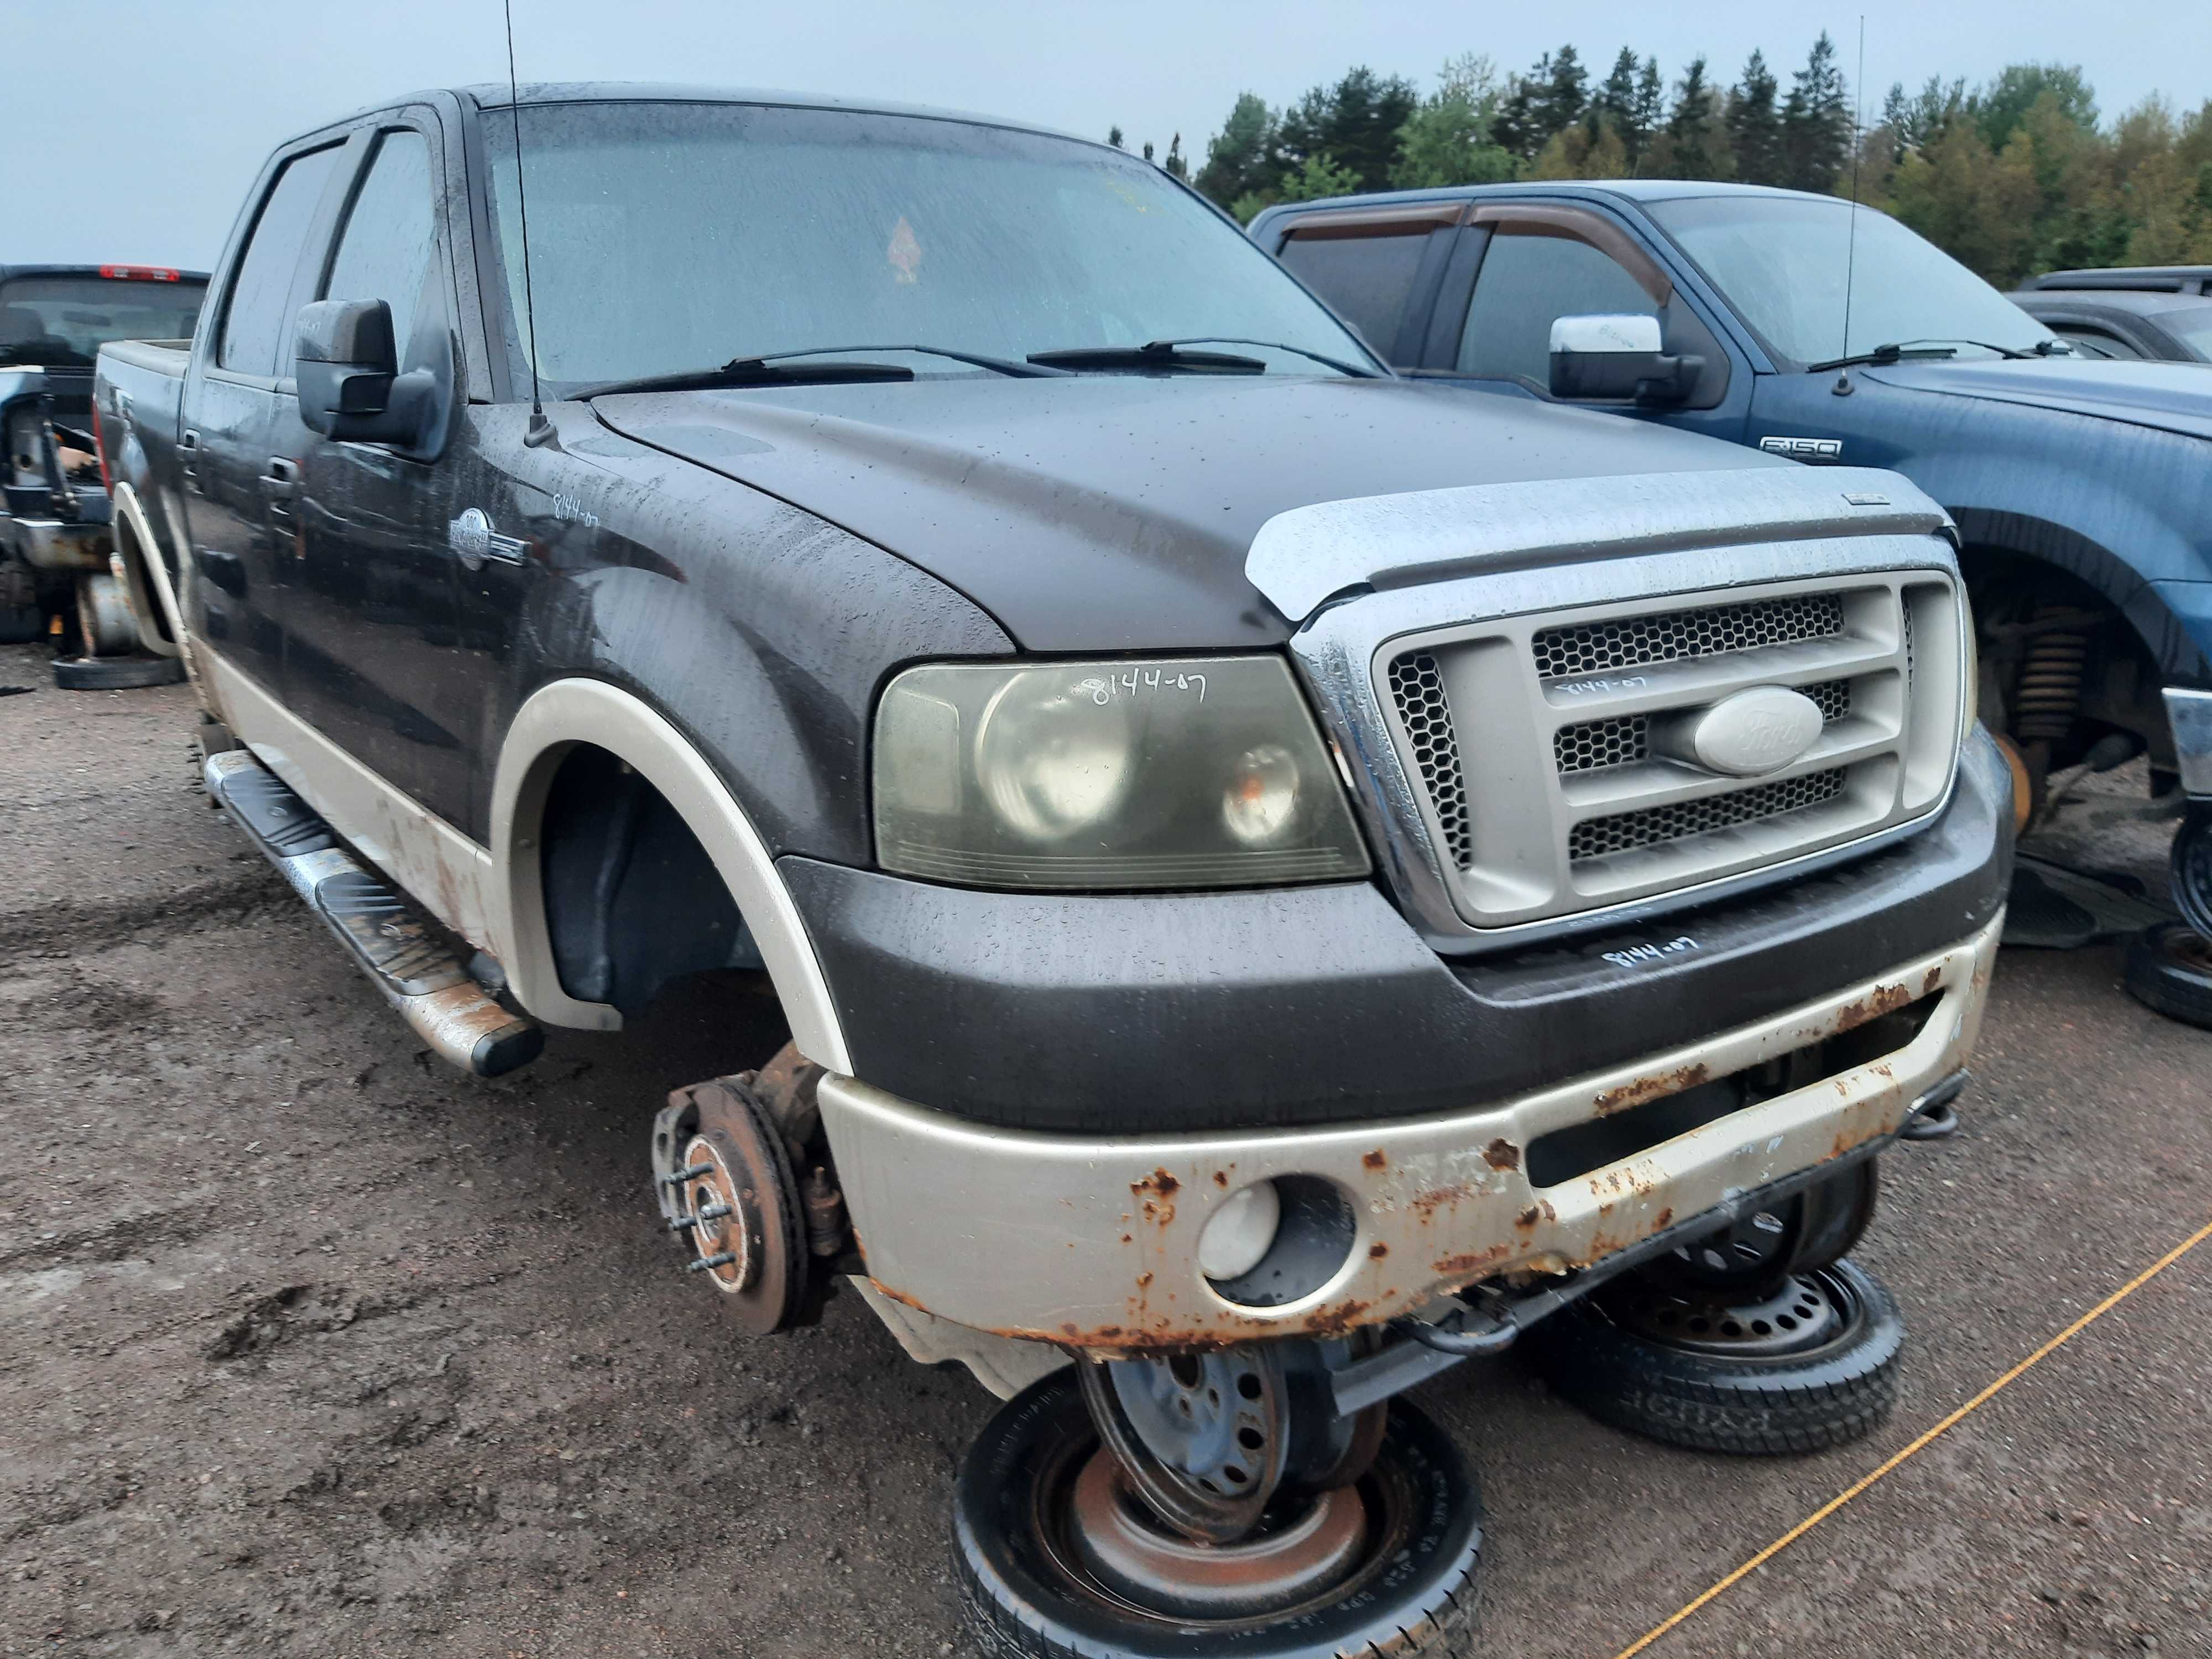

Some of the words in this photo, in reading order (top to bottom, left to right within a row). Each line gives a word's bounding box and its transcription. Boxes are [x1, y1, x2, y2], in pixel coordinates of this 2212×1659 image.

[1080, 667, 1207, 705] 8144-07
[1554, 676, 1647, 695] 8144-07
[1601, 936, 1699, 968] 8144-07
